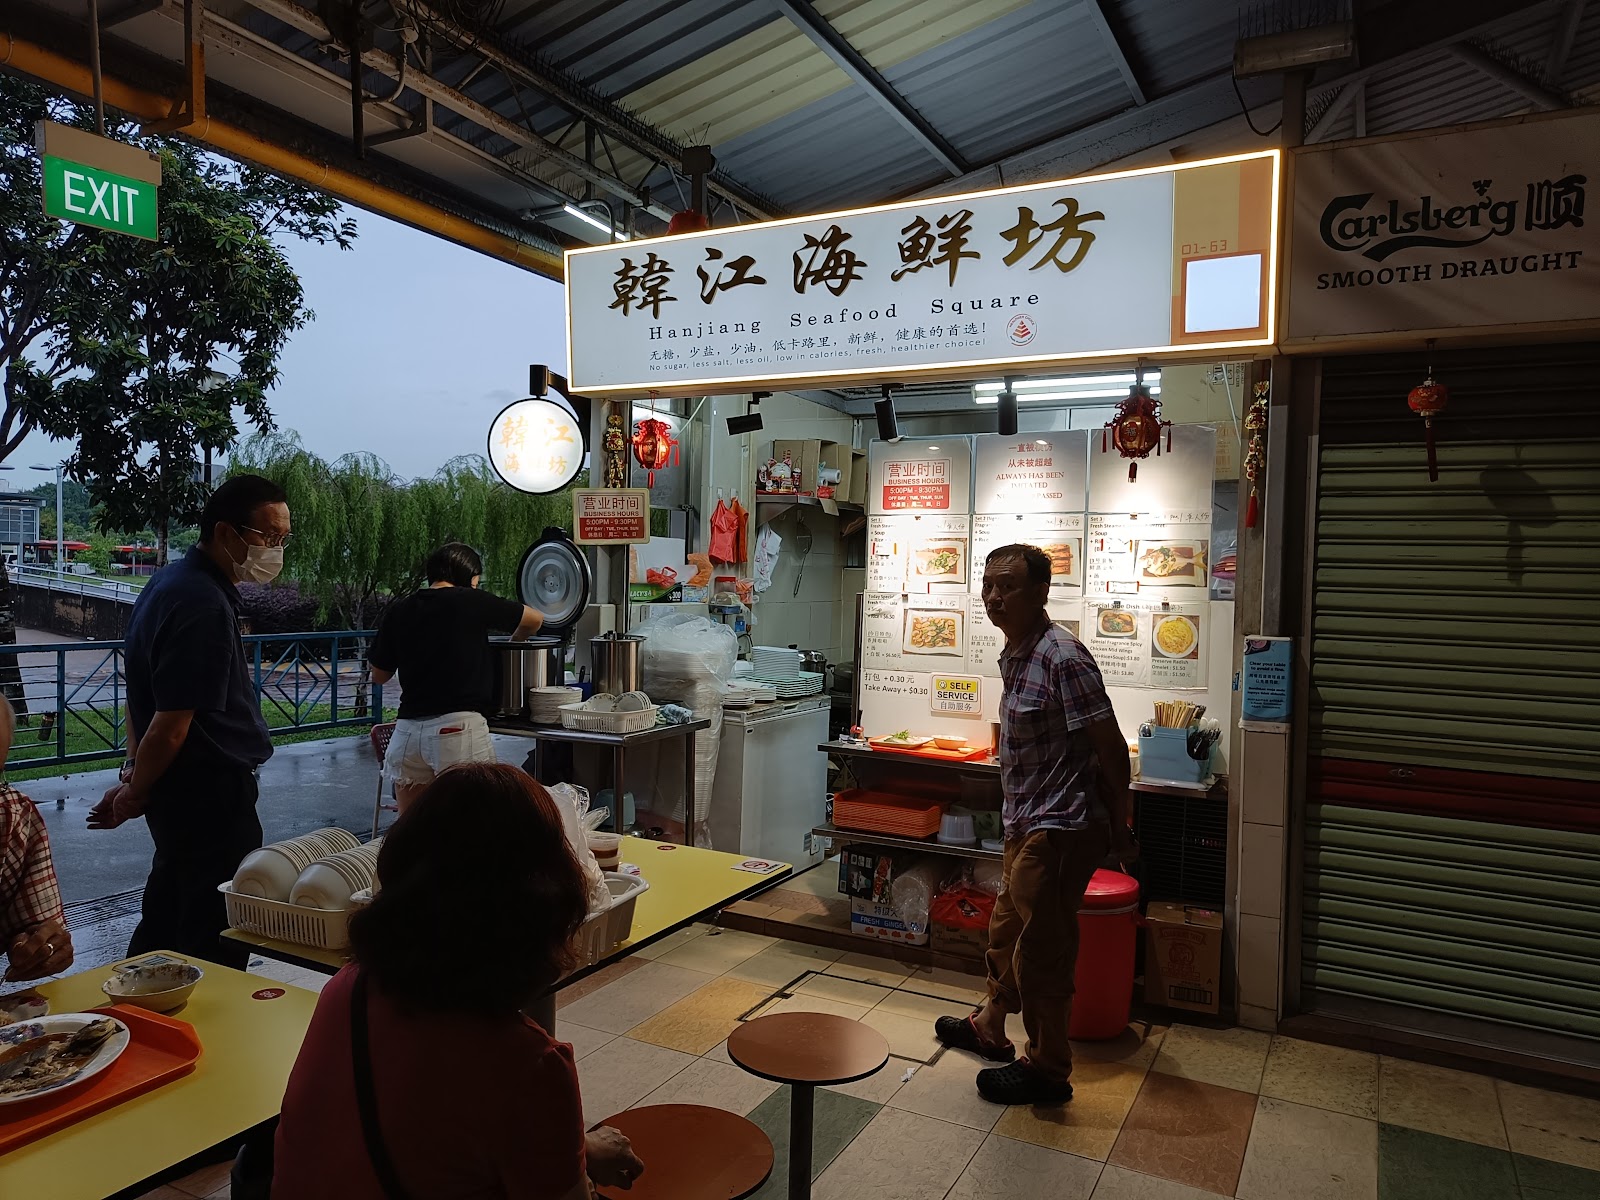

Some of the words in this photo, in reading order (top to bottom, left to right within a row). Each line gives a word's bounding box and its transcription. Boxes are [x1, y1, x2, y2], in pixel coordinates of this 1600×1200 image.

[64, 170, 139, 226] EXIT
[1525, 174, 1587, 231] 顺
[1320, 192, 1519, 254] Carlsberg
[1182, 240, 1227, 255] 01-63
[608, 198, 1106, 320] 韓江海鮮坊
[1317, 264, 1432, 290] SMOOTH
[1440, 251, 1583, 279] DRAUGHT
[649, 321, 761, 340] Hanjiang
[790, 303, 897, 328] Seafood
[931, 294, 1039, 314] Square
[664, 362, 689, 371] sugar,
[713, 359, 732, 367] salt,
[736, 357, 754, 365] less
[757, 355, 772, 364] oil,
[776, 354, 793, 362] low
[810, 350, 851, 360] calories,
[856, 346, 886, 355] fresh,
[891, 342, 940, 353] healthier
[504, 452, 567, 475] 海坊
[889, 462, 945, 477] 营业时间
[1008, 458, 1053, 468] 从未被超越
[583, 497, 639, 510] 营业时间
[864, 672, 880, 681] 打包
[906, 676, 915, 684] 元
[882, 685, 900, 694] Away
[909, 687, 928, 695] $0.30
[949, 682, 972, 690] SELF
[937, 691, 974, 700] SERVICE
[940, 701, 972, 711] 自助服务
[874, 905, 898, 917] 特级大
[860, 916, 880, 925] FRESH
